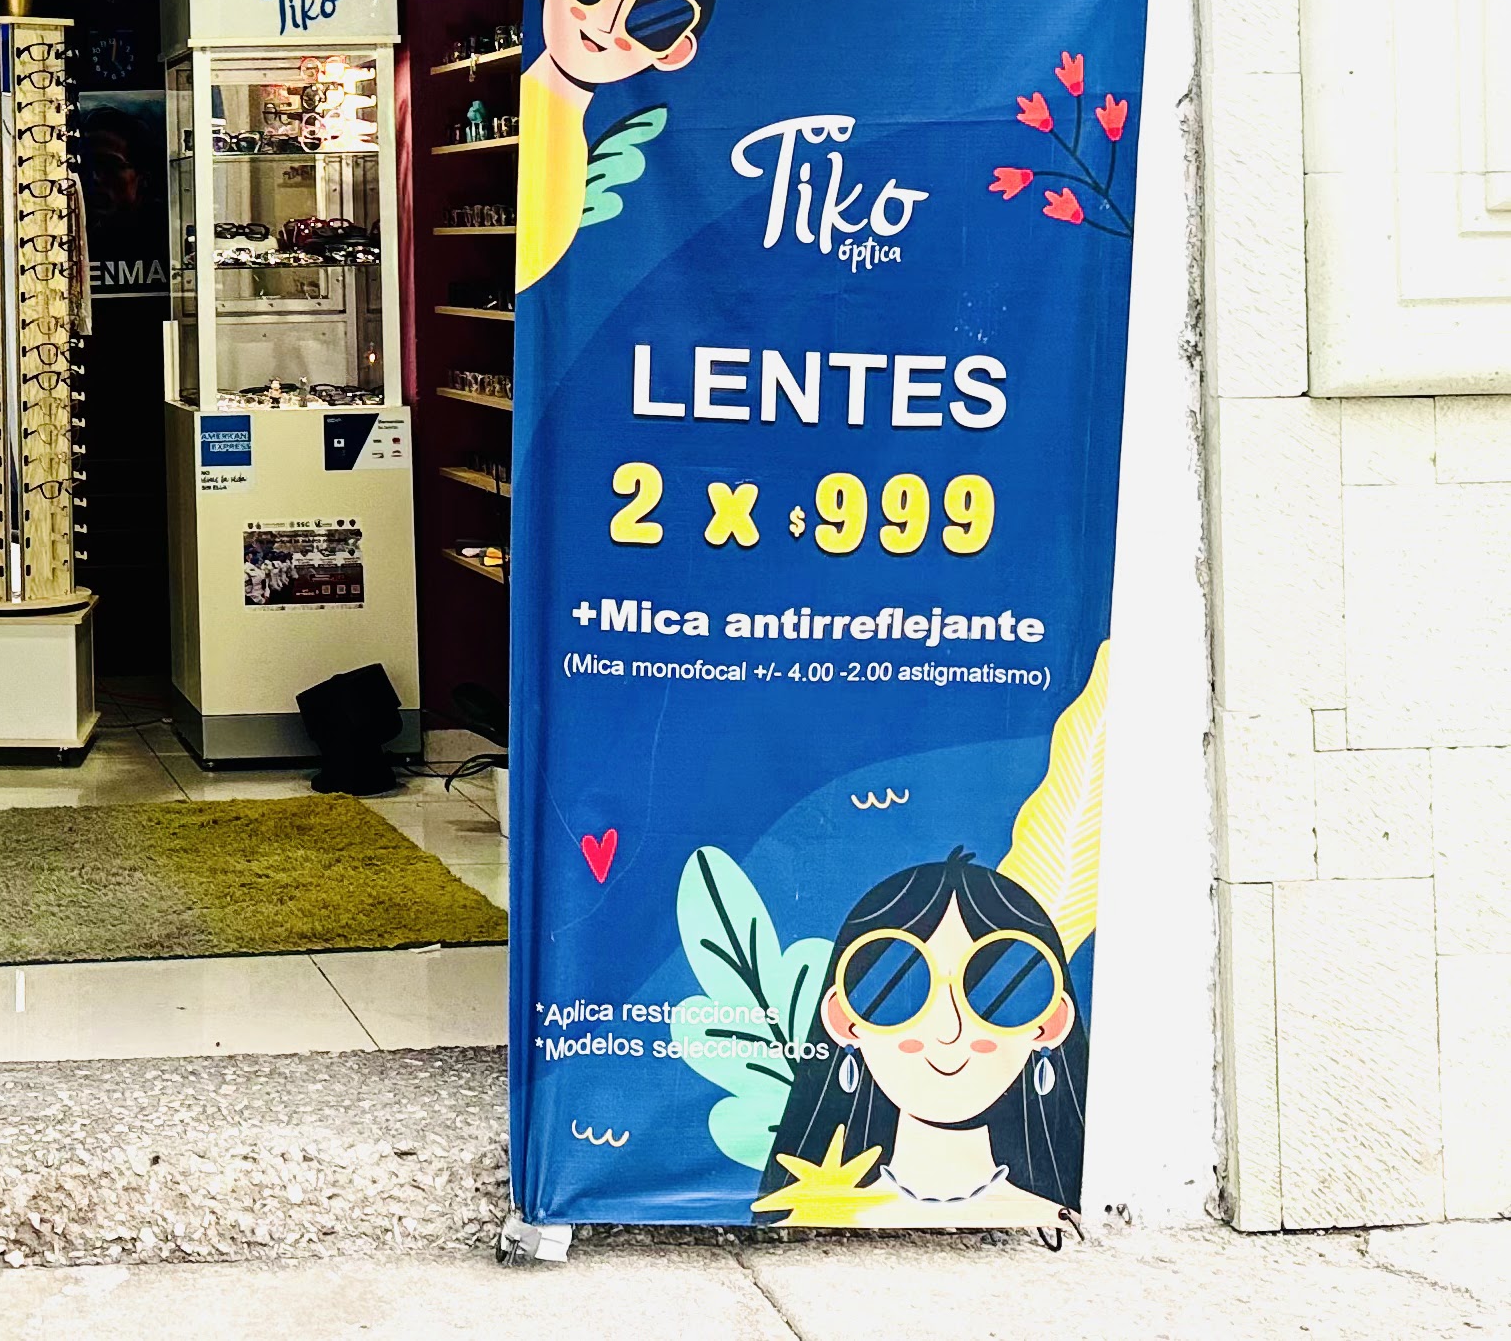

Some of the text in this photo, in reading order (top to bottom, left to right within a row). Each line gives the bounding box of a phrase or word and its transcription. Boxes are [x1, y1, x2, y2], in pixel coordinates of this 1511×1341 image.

[730, 114, 930, 255] Tiko
[837, 236, 902, 274] óptica
[632, 343, 1008, 430] LENTES
[609, 461, 664, 545] 2
[788, 471, 995, 555] $999
[571, 597, 1046, 648] +Mica antirreflejante
[563, 652, 1051, 691] (Mica monofocal +/- 4.00 -2.00 astigmatismo)
[622, 1000, 780, 1025] restricciones
[652, 1036, 830, 1063] seleccionados
